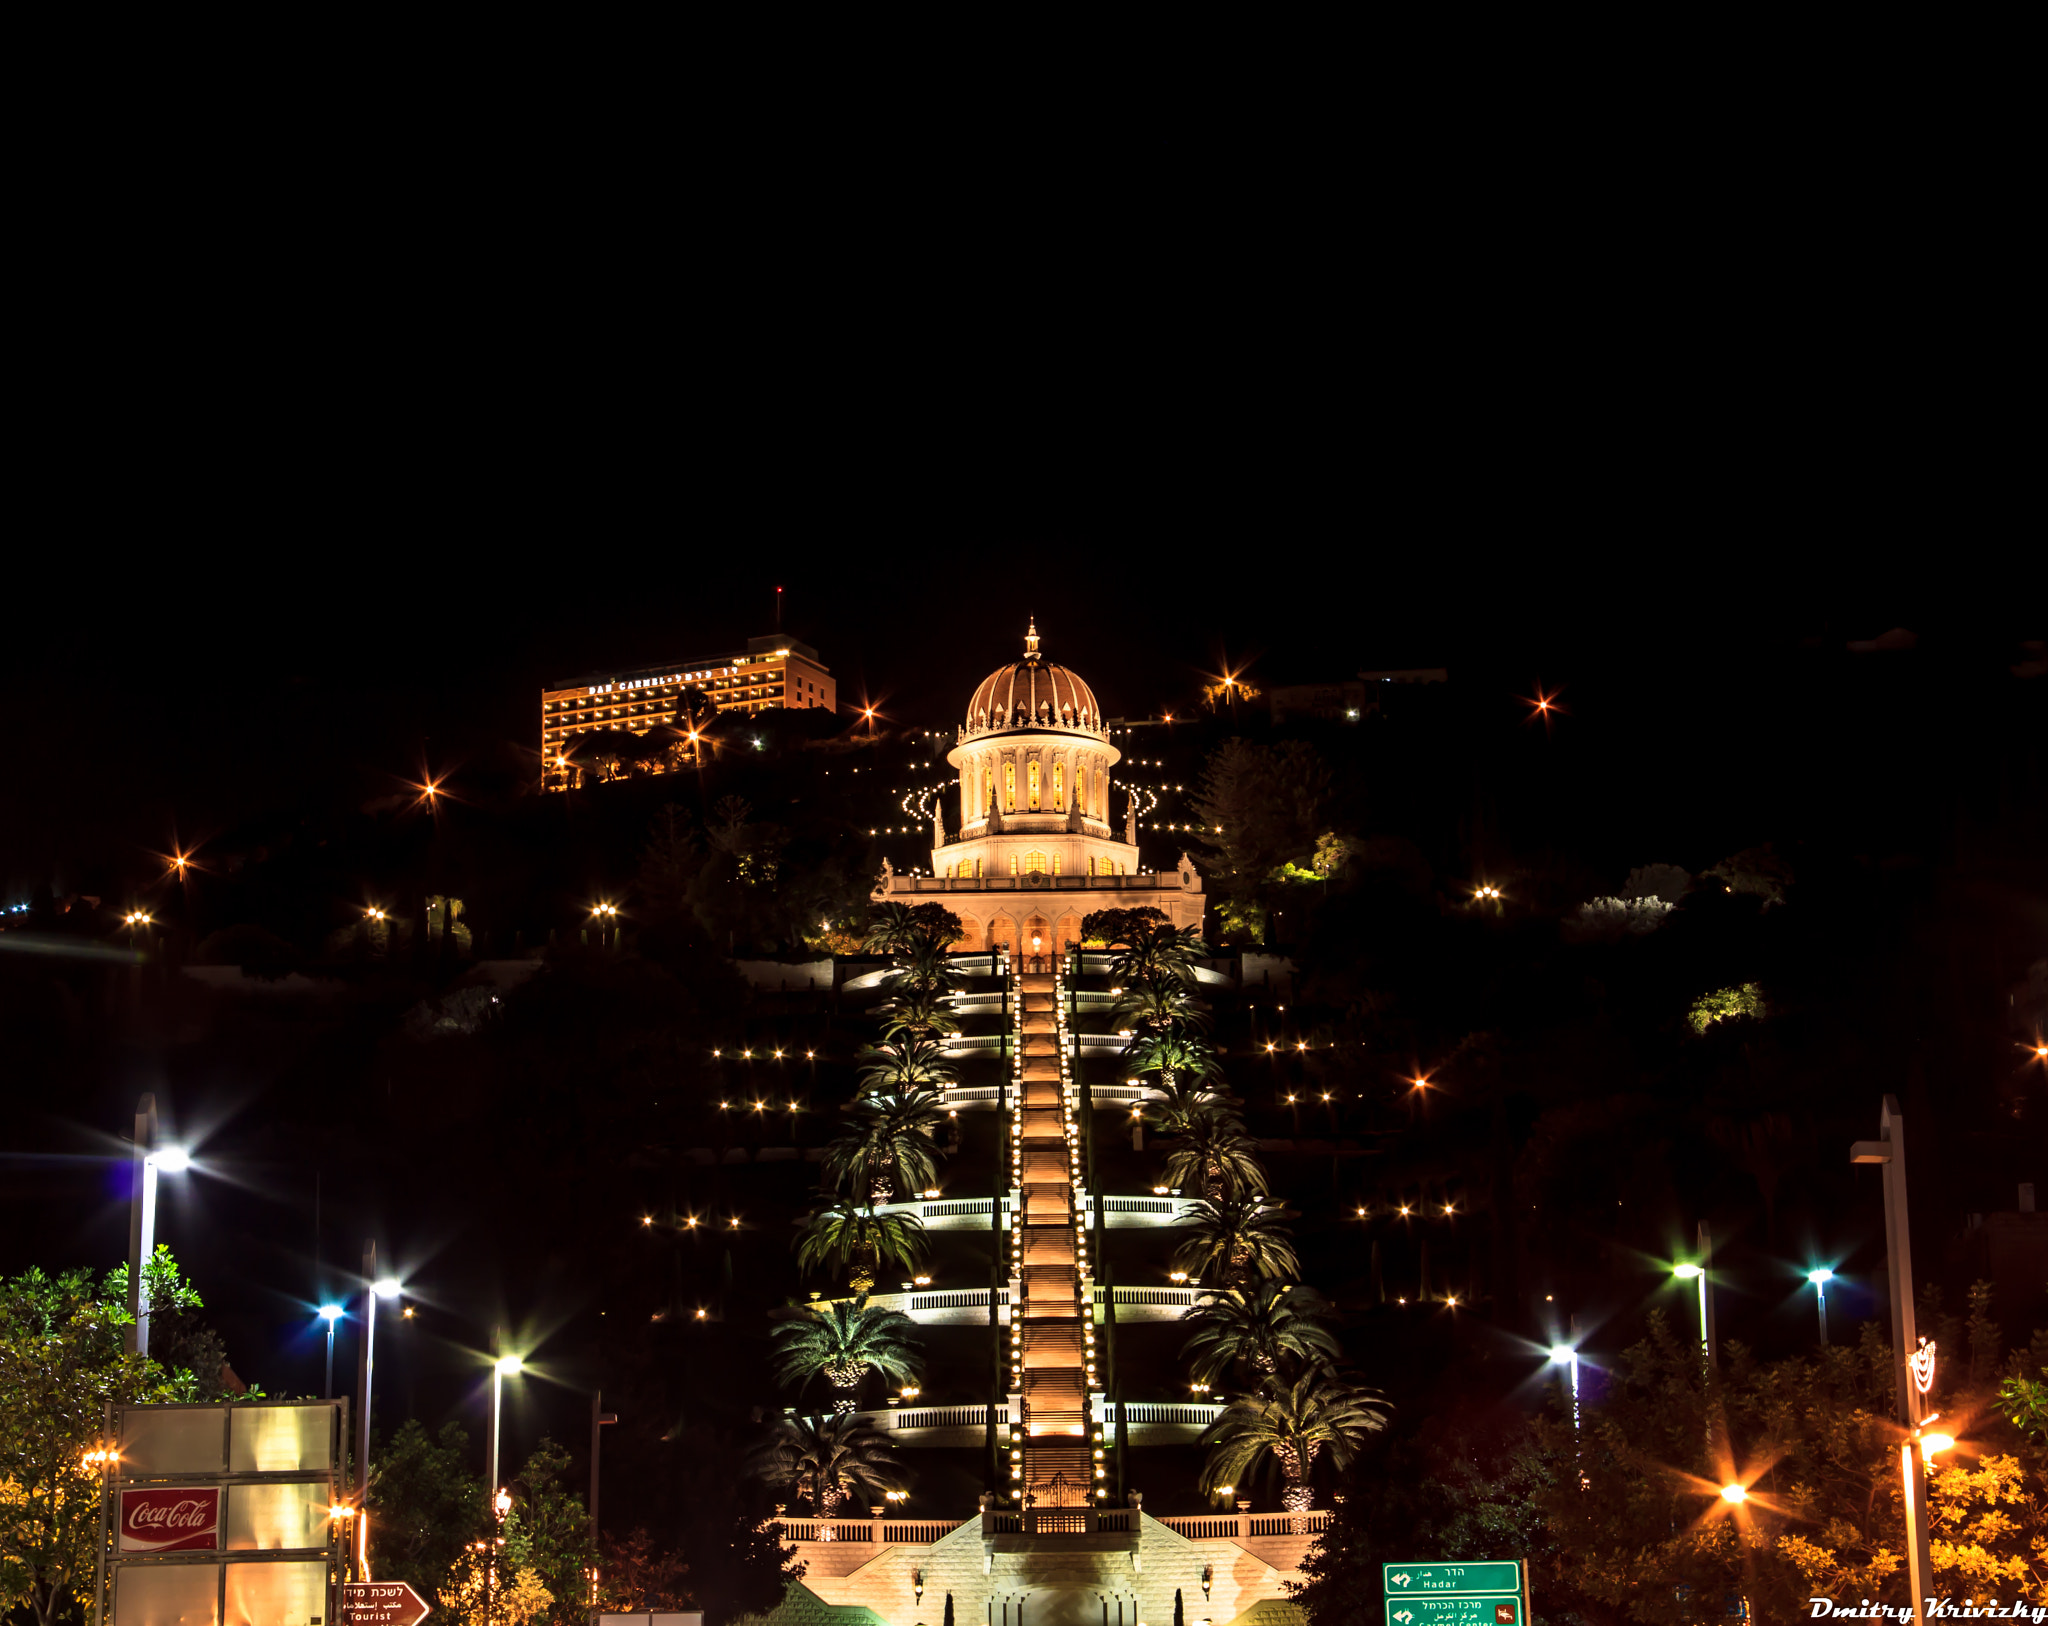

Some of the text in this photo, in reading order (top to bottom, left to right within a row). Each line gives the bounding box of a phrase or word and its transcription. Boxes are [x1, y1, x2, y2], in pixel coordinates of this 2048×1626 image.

[588, 676, 666, 695] DAN CARMEL
[1444, 1568, 1465, 1576] הדר
[1423, 1580, 1457, 1588] Hadar
[370, 1586, 404, 1597] לשכת
[1422, 1601, 1482, 1610] מרכז הכרמל
[349, 1612, 391, 1620] Tourist
